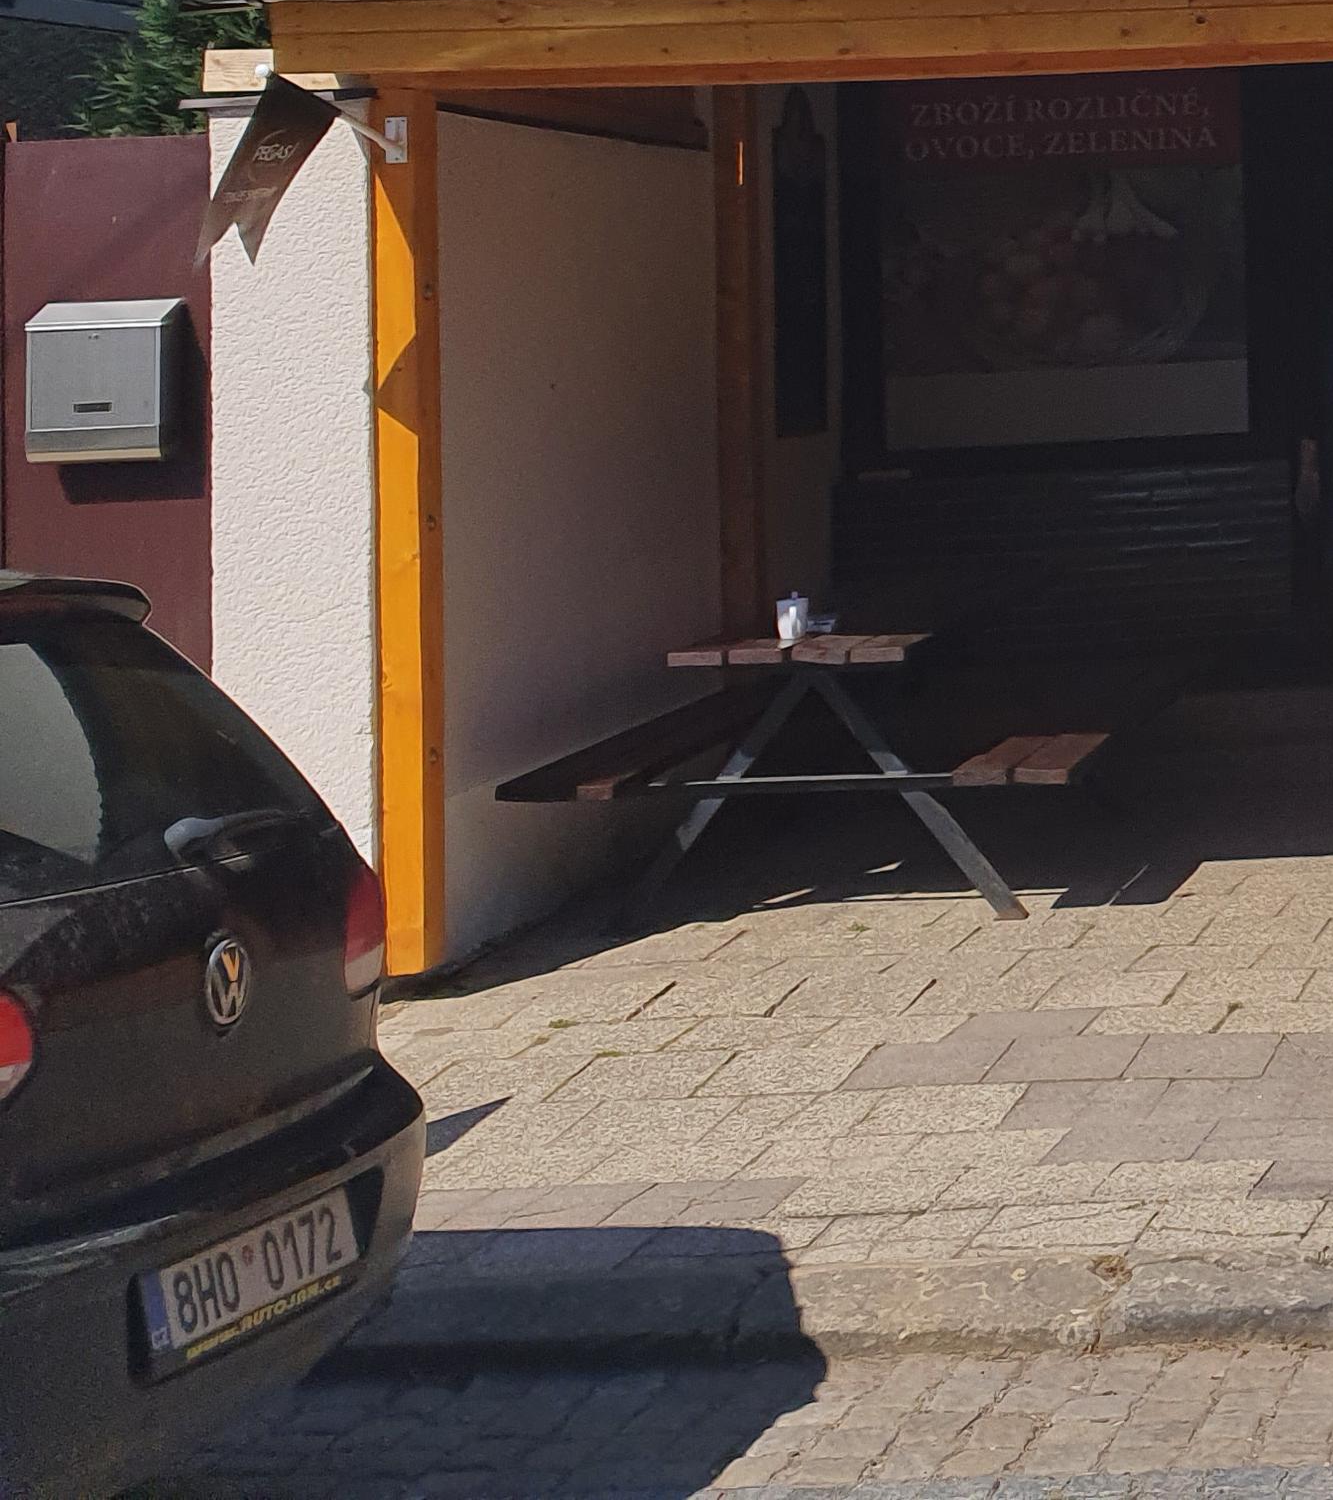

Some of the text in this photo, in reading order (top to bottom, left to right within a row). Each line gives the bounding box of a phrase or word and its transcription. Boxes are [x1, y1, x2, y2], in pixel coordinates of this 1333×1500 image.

[911, 86, 1210, 127] ZBOŽÍ ROZLIČNÉ,
[905, 126, 1218, 162] OVOCE, ZELENINA
[260, 1205, 343, 1291] 0172
